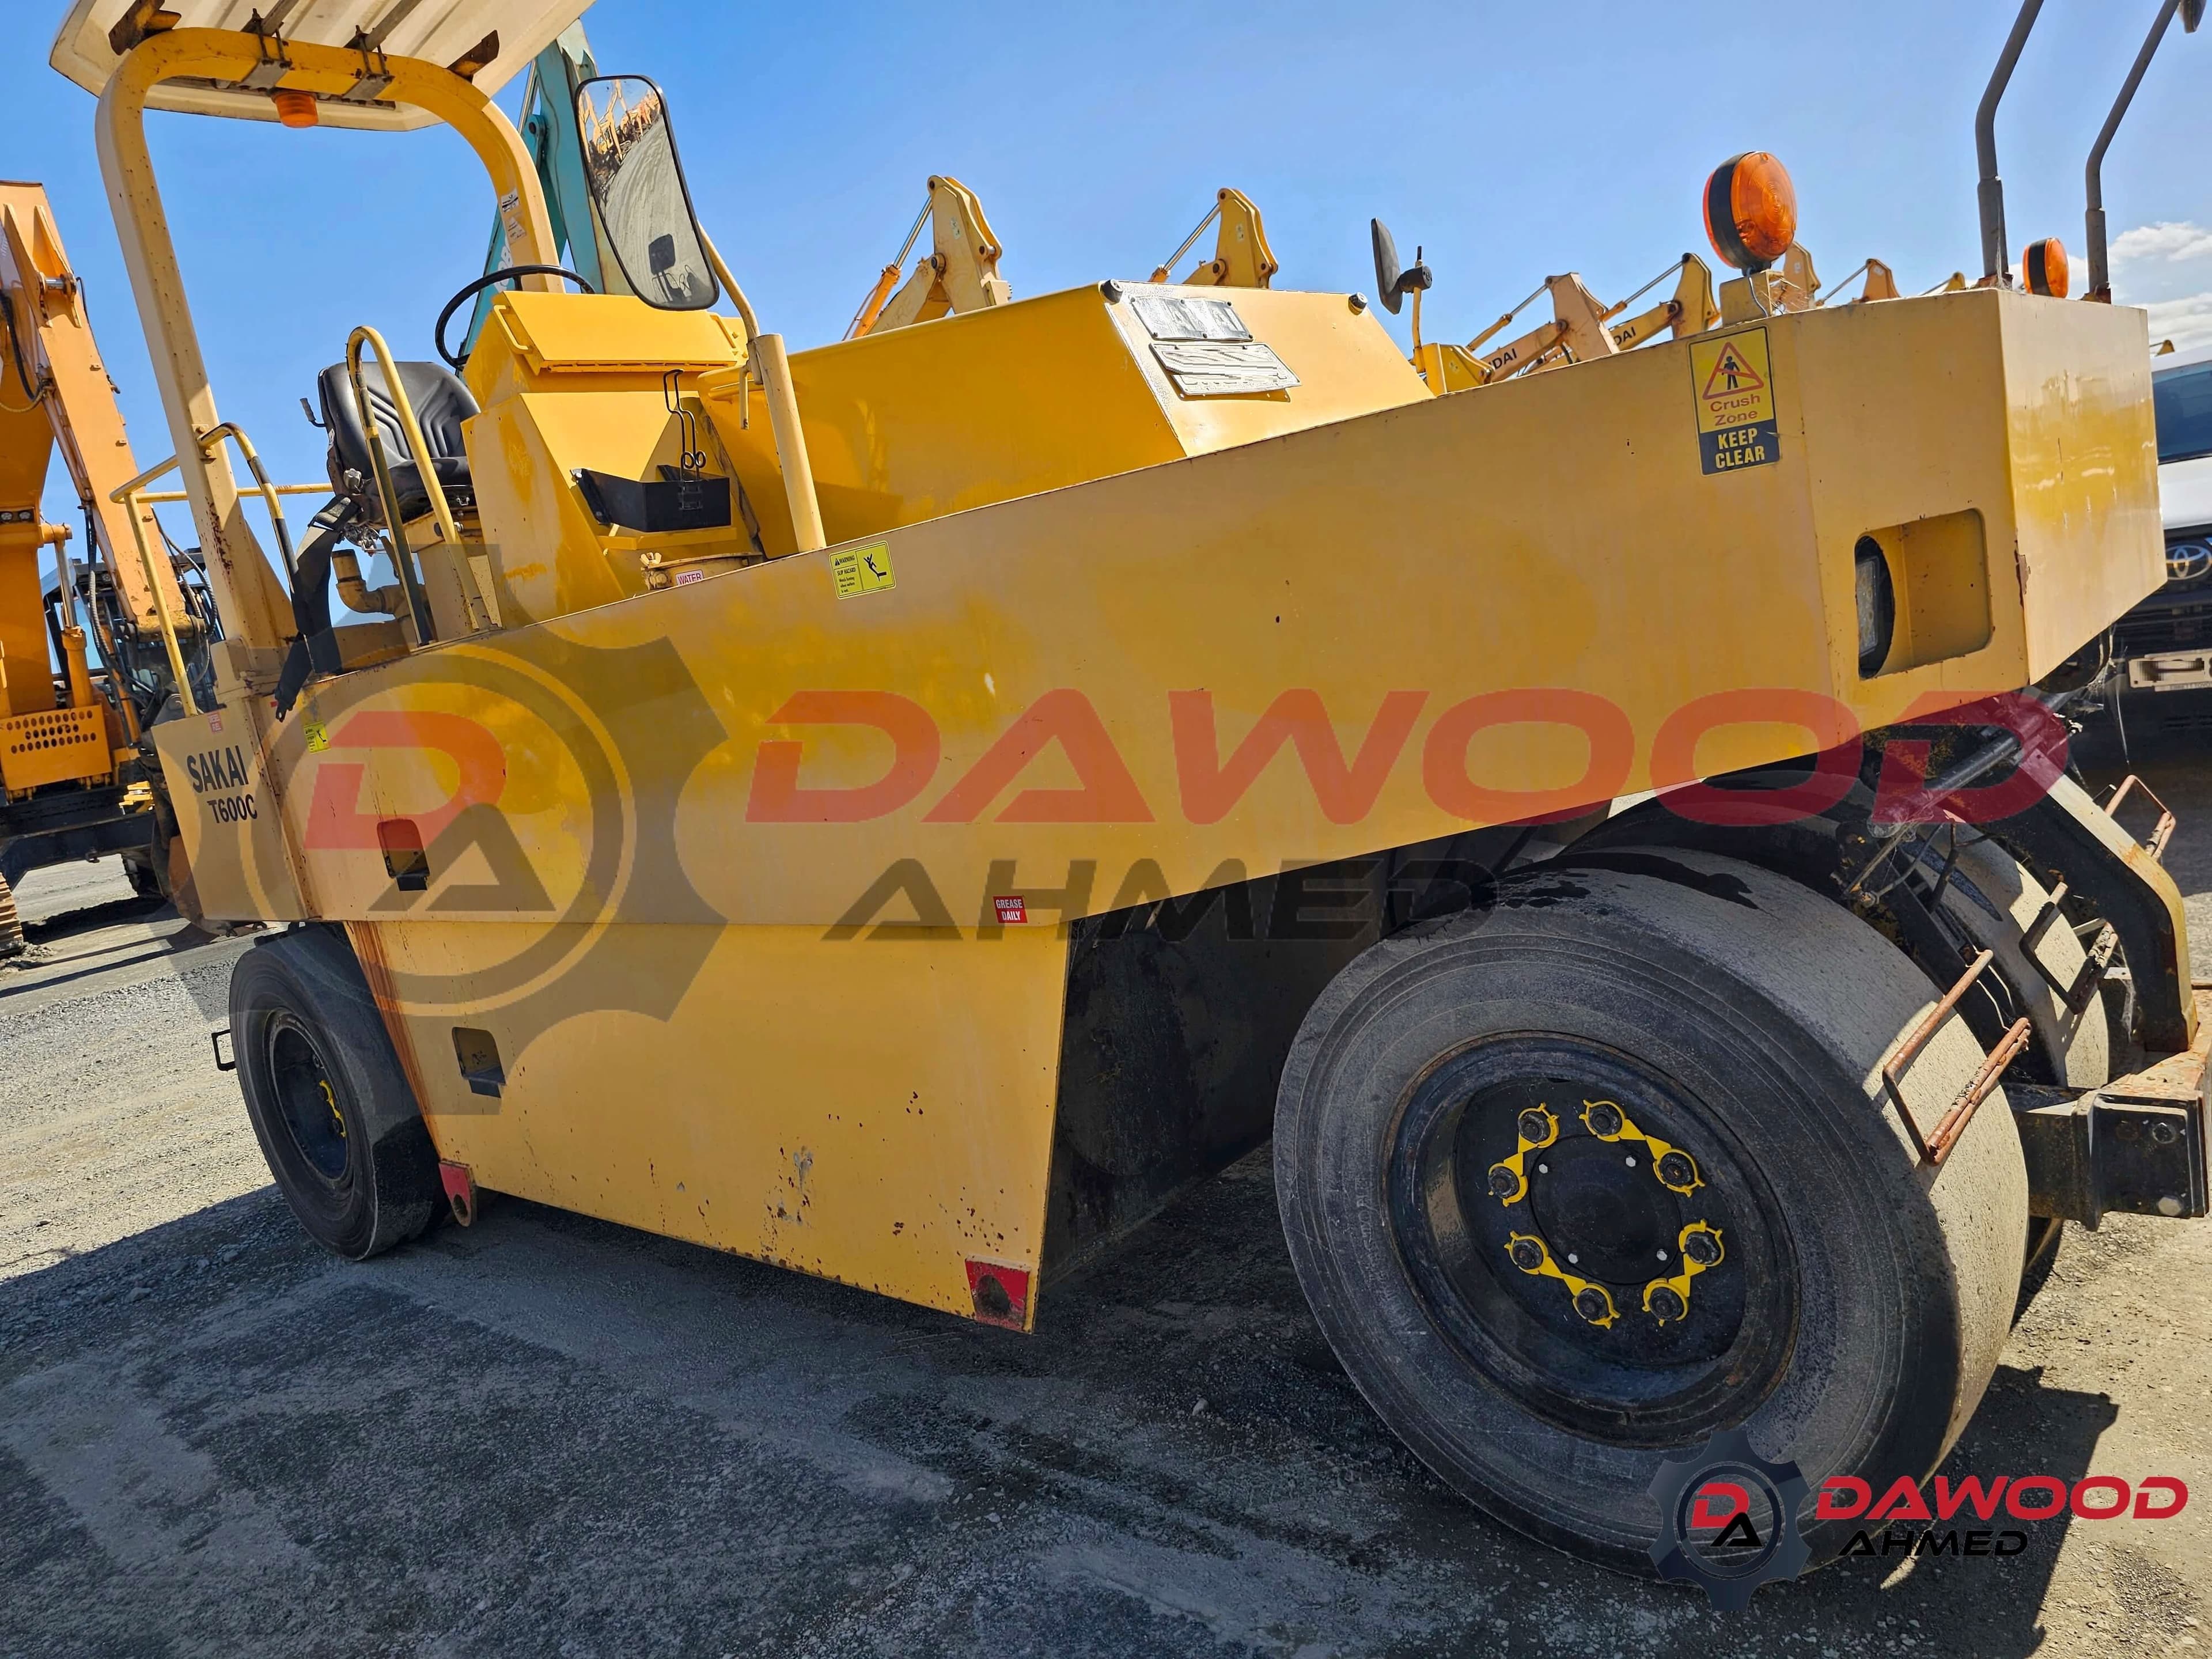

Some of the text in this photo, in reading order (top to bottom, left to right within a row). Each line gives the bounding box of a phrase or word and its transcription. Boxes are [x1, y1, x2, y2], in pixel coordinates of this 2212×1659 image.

[1710, 393, 1760, 412] Crush
[1714, 411, 1758, 426] Zone
[1717, 427, 1758, 450] KEEP
[1715, 445, 1765, 469] CLEAR
[678, 573, 702, 585] WATER
[187, 745, 249, 793] SAKAI
[207, 794, 258, 824] T600C
[995, 899, 1023, 909] GREASE
[1001, 911, 1021, 921] DAILY
